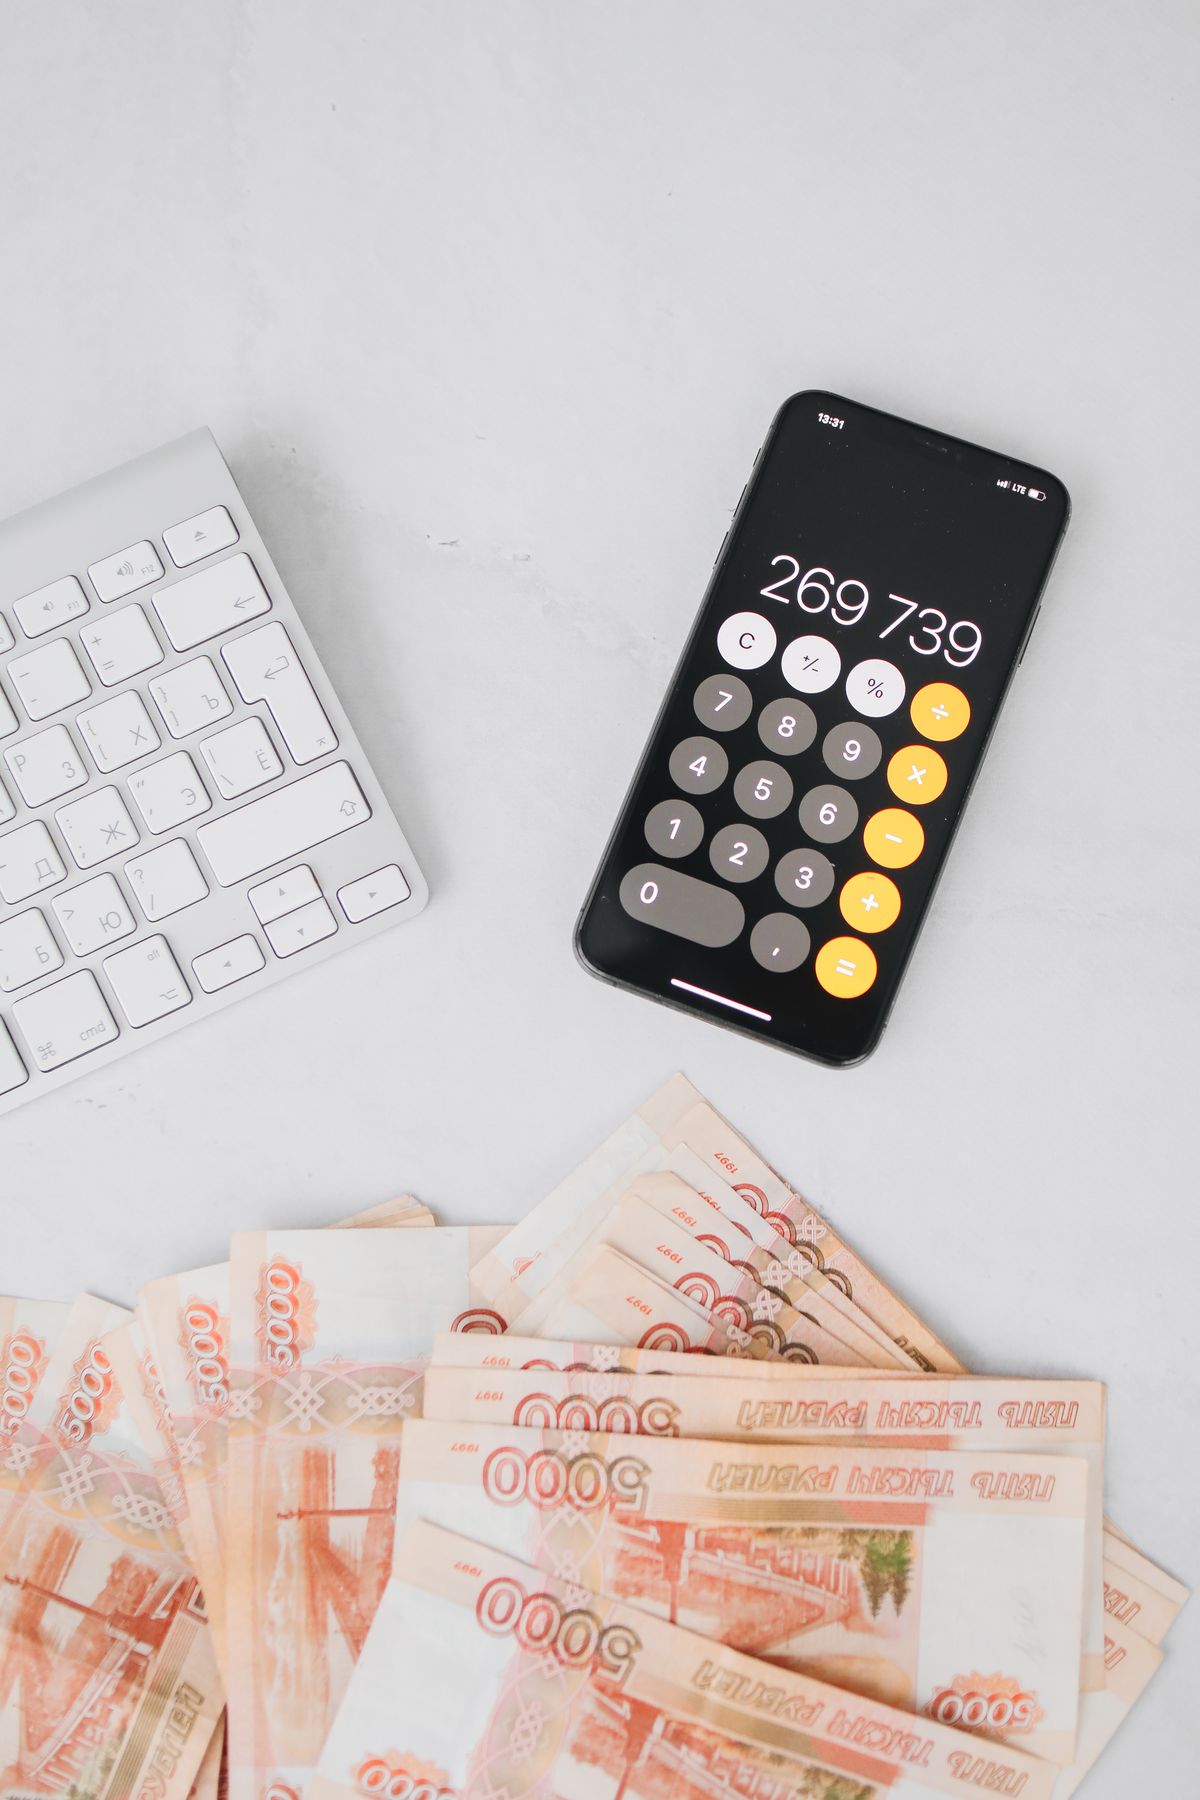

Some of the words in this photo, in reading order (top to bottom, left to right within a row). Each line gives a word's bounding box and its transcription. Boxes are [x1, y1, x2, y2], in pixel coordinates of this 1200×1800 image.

[818, 412, 845, 430] 13:31
[1011, 483, 1027, 495] LTE
[141, 564, 156, 576] F12
[760, 555, 870, 625] 269
[878, 593, 982, 667] 739
[738, 632, 756, 650] C
[867, 678, 884, 699] %
[201, 694, 220, 710] Ъ
[713, 691, 732, 712] 7
[777, 716, 796, 738] 8
[255, 748, 271, 771] Ё
[842, 739, 861, 762] 9
[689, 755, 707, 777] 4
[180, 787, 197, 806] Э
[754, 777, 773, 801] 5
[818, 802, 838, 826] 6
[100, 820, 127, 845] Ж
[669, 818, 681, 840] 1
[729, 842, 748, 866] 2
[34, 857, 56, 883] Д
[795, 867, 813, 890] 3
[639, 882, 658, 904] 0
[99, 910, 122, 933] Ю
[35, 945, 50, 964] Б
[147, 949, 161, 961] alt
[80, 1021, 106, 1042] cmd
[714, 1151, 738, 1175] 1997
[671, 1206, 696, 1227] 1997
[656, 1244, 683, 1264] 1997
[265, 1262, 301, 1369] 5000
[626, 1295, 652, 1316] 1997
[185, 1302, 229, 1405] 5000
[482, 1356, 511, 1368] 1997
[475, 1391, 503, 1402] 1997
[736, 1399, 868, 1431] РУБЛЕЙ
[876, 1400, 983, 1429] ТЫСЯЧ
[997, 1400, 1080, 1430] ПЯТЬ
[451, 1442, 479, 1454] 1997
[482, 1446, 651, 1513] 5000
[706, 1462, 838, 1494] РУБЛЕЙ
[846, 1466, 954, 1498] ТЫСЯЧ
[970, 1471, 1056, 1502] ПЯТЬ
[454, 1561, 482, 1578] 1997
[476, 1577, 643, 1685] 5000
[691, 1658, 824, 1726] РУБЛЕЙ
[934, 1690, 1034, 1729] 5000
[828, 1707, 935, 1768] ТЫСЯЧ
[358, 1759, 461, 1800] 000
[947, 1750, 1030, 1798] ПЯТЬ
